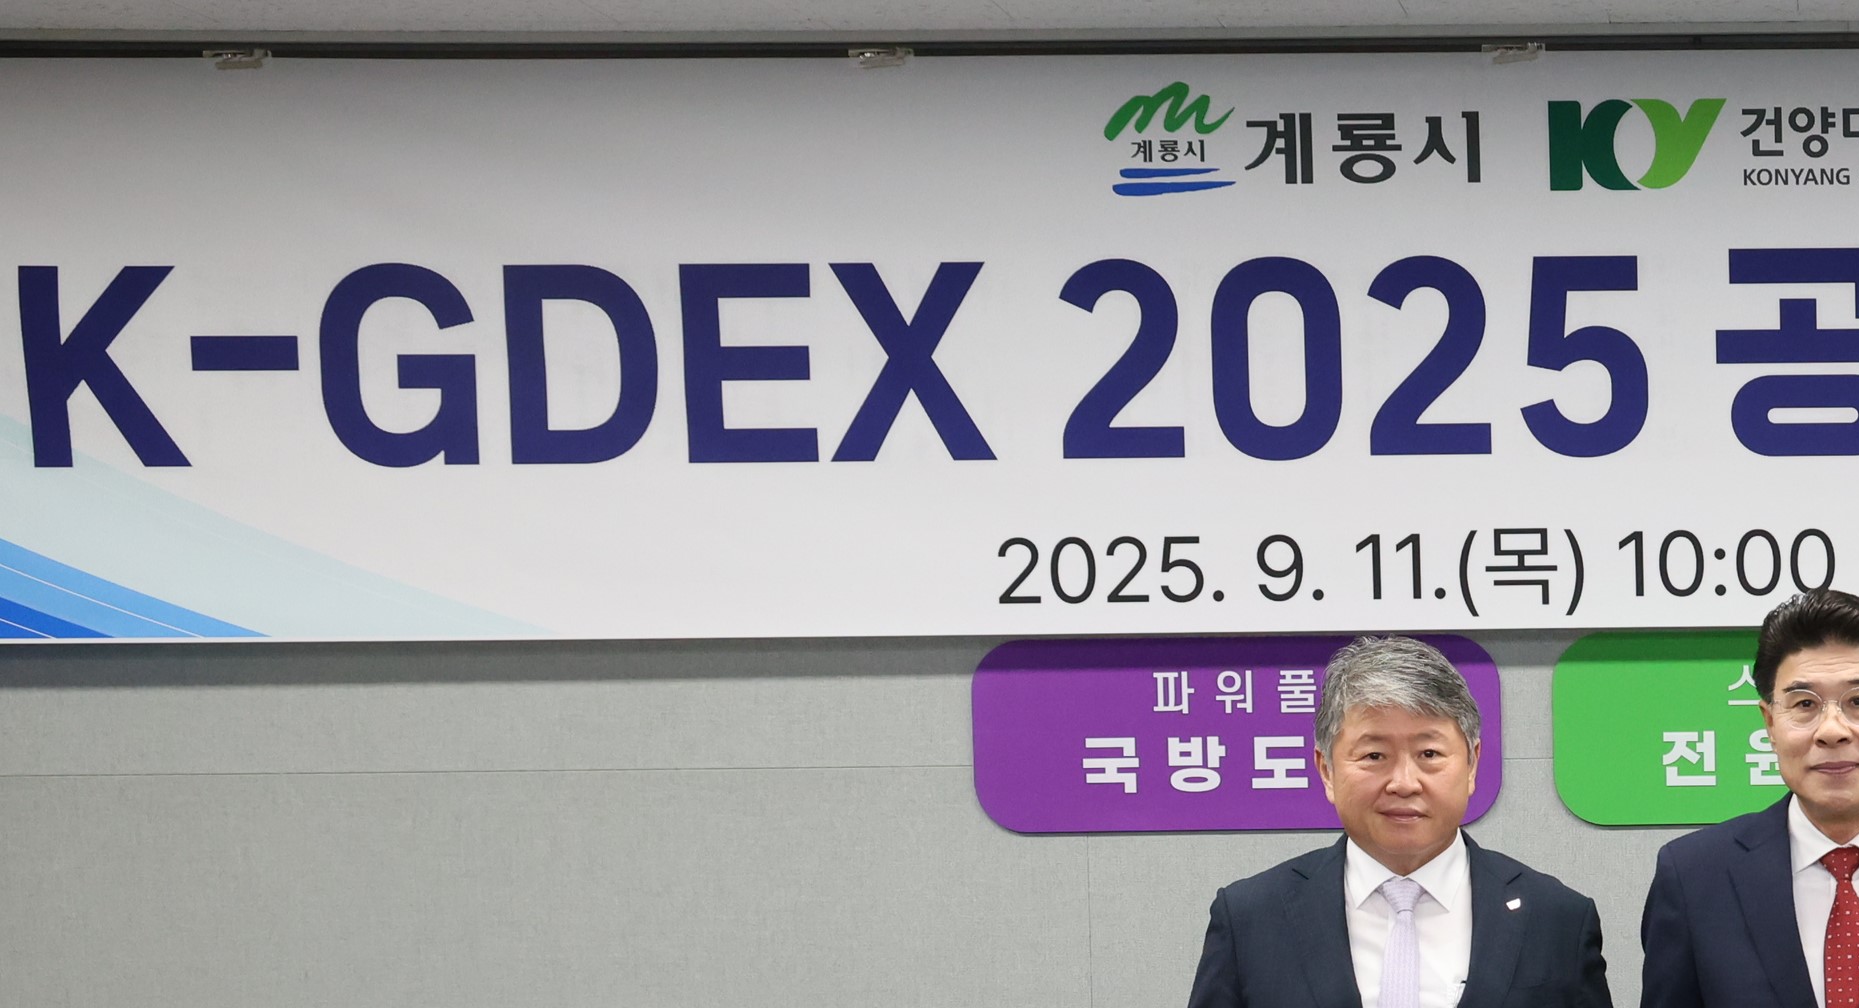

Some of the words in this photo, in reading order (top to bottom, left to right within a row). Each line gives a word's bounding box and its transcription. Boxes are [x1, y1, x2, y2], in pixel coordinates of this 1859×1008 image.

[1130, 139, 1206, 163] 계룡시
[1244, 110, 1481, 185] 계룡시
[1548, 98, 1728, 191] KY
[1743, 167, 1851, 186] KONYANG
[18, 262, 997, 468] K-GDEX
[1059, 255, 1648, 461] 2025
[997, 535, 1225, 605] 2025.
[1256, 533, 1325, 603] 9.
[1618, 527, 1837, 597] 10:00
[1152, 669, 1318, 715] 파워풀
[1081, 735, 1310, 795] 국방도
